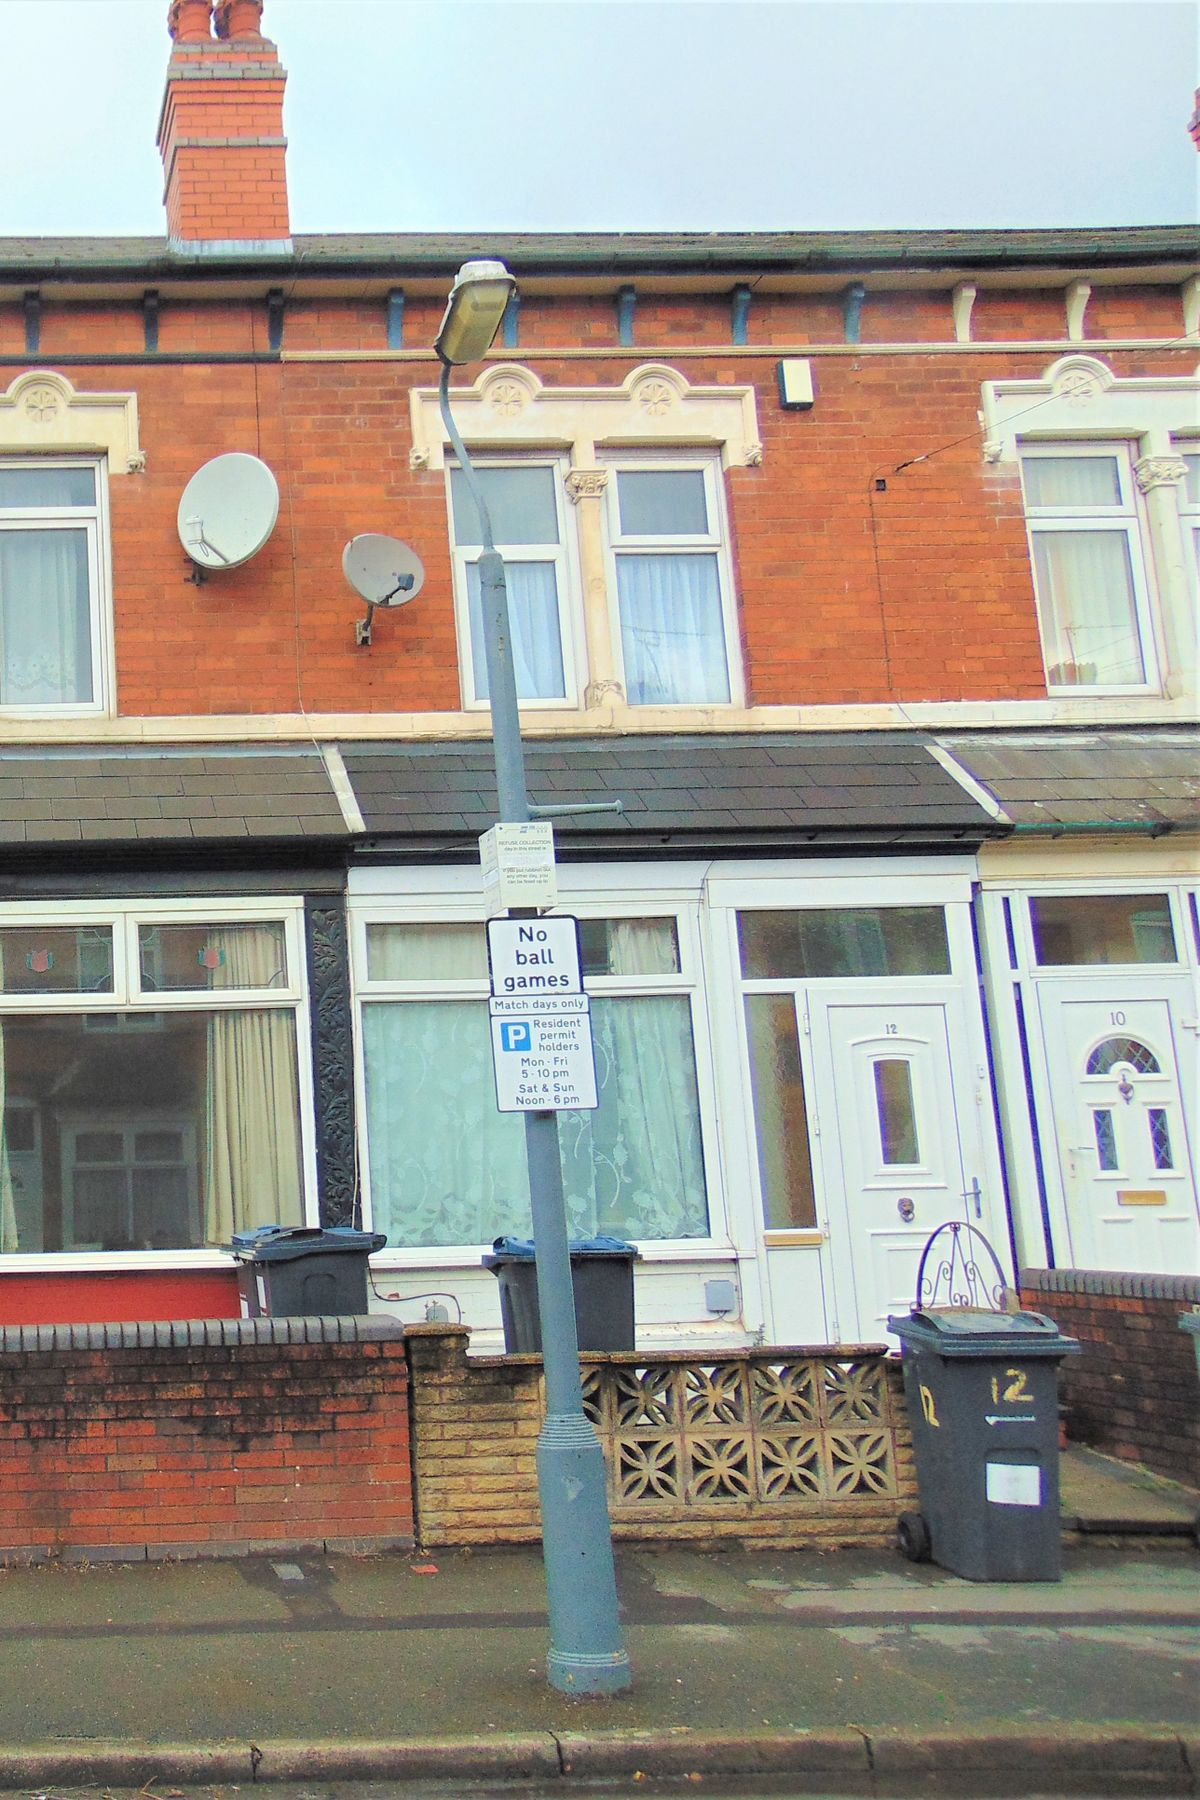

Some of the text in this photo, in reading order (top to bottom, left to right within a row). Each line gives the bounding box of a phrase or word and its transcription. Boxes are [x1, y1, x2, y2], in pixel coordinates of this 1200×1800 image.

[518, 926, 548, 942] No
[516, 949, 554, 965] ball
[504, 973, 570, 992] games
[495, 997, 584, 1011] Match days only
[533, 1018, 581, 1029] Resident
[1110, 1011, 1126, 1026] 10
[885, 1023, 898, 1035] 12
[507, 1025, 527, 1049] P
[540, 1030, 576, 1041] permit
[538, 1042, 580, 1052] holders
[521, 1057, 545, 1067] Mon
[553, 1056, 568, 1066] Fri
[521, 1069, 529, 1079] 5
[537, 1068, 550, 1078] 10
[552, 1070, 569, 1079] pm
[519, 1083, 575, 1094] Sat & Sun
[515, 1096, 545, 1105] Noon
[553, 1095, 561, 1104] 6
[563, 1096, 580, 1105] pm
[991, 1368, 1035, 1405] 12
